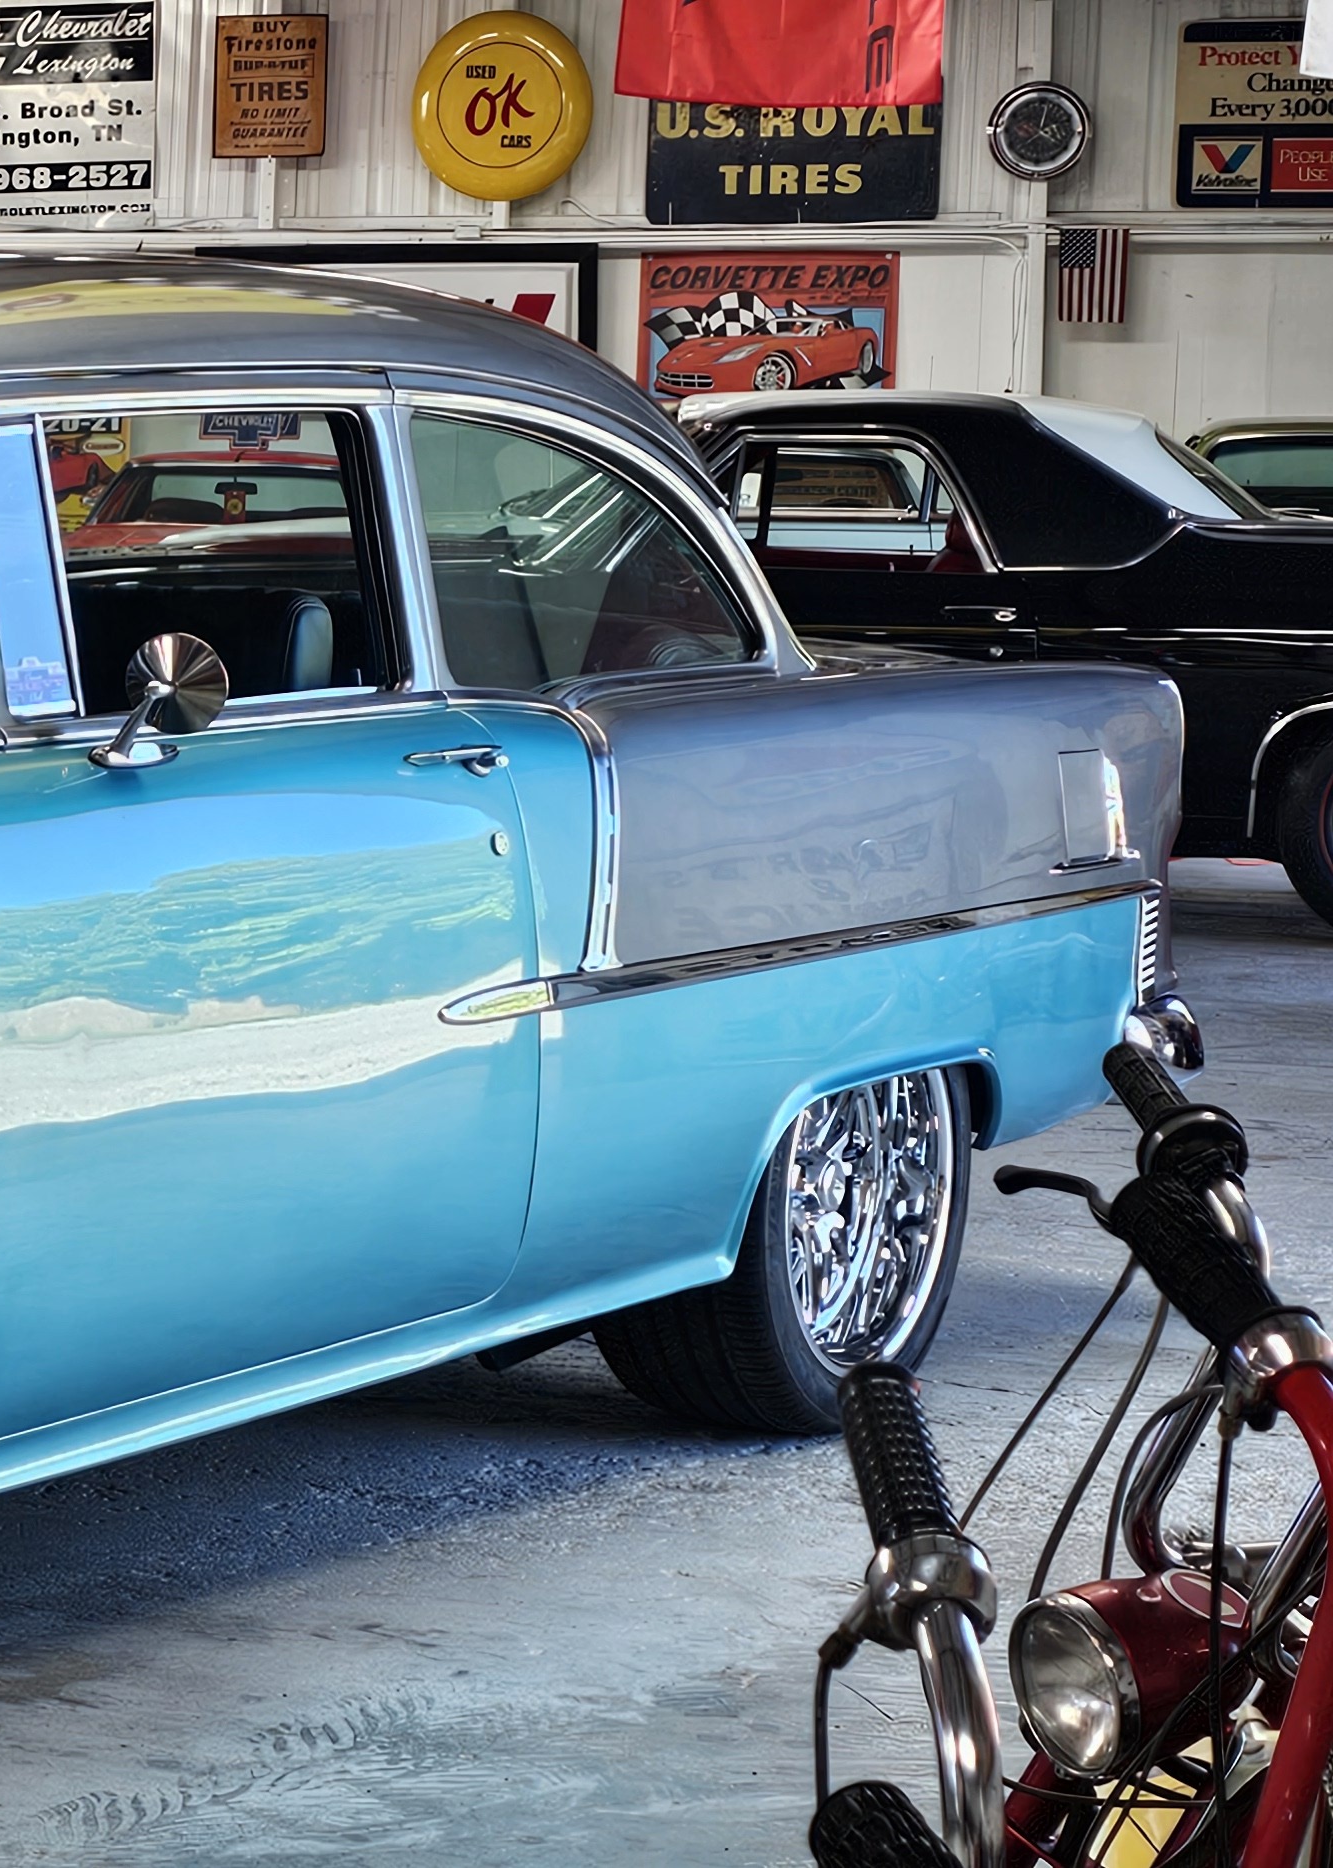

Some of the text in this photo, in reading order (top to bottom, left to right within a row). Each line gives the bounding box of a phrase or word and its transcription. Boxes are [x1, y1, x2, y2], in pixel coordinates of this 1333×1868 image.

[16, 10, 152, 47] Chevrolet
[253, 21, 291, 33] BUY
[224, 36, 317, 55] Firestone
[1198, 45, 1281, 66] Protect
[13, 50, 135, 79] Lexington
[466, 65, 496, 79] USED
[230, 81, 309, 102] TIRES
[21, 99, 95, 119] Broad
[108, 99, 142, 116] St.
[241, 107, 300, 119] NO LIMIT
[465, 72, 536, 136] OK
[1209, 97, 1275, 121] Every
[656, 102, 934, 139] U.S. ROYAL
[91, 124, 122, 142] TN
[233, 126, 308, 139] GUARANTEE
[500, 135, 532, 148] CARS
[718, 164, 862, 195] TIRES
[1298, 167, 1329, 182] USE
[650, 265, 890, 289] CORVETTE EXPO
[44, 417, 120, 433] 20-21
